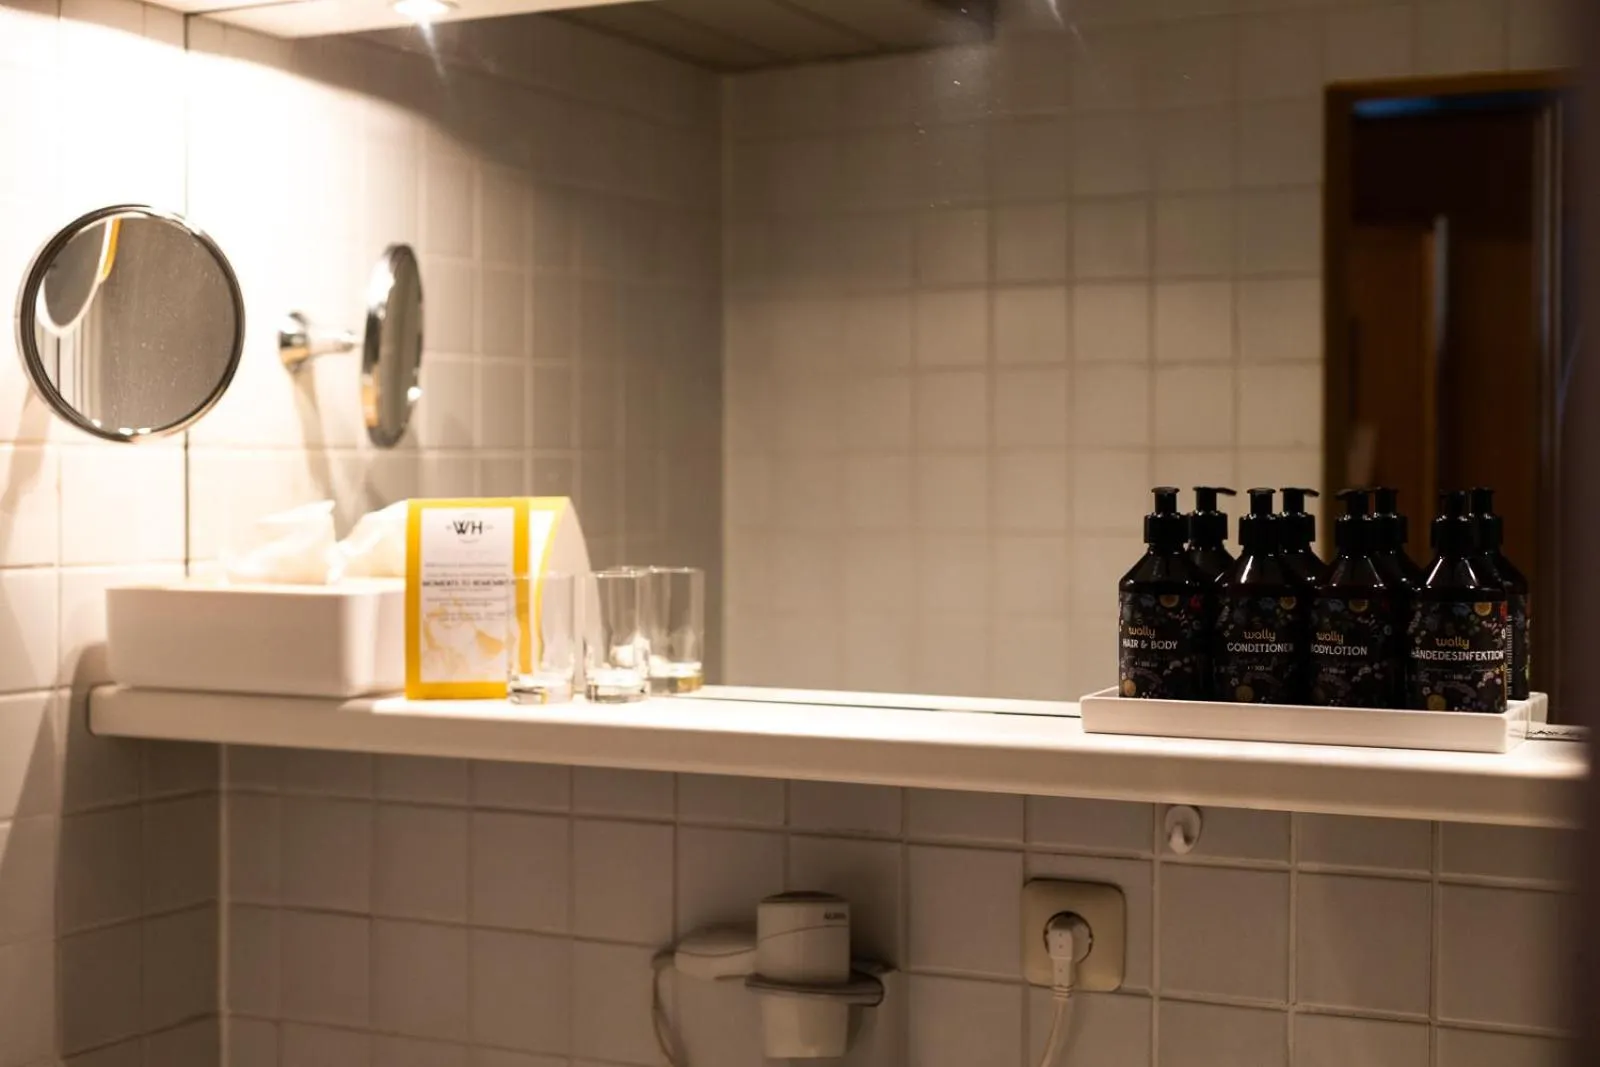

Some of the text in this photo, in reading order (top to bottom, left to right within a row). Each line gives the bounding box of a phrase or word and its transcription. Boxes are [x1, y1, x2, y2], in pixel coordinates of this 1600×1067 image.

[452, 519, 484, 535] WH
[1128, 625, 1156, 639] wally
[1243, 627, 1276, 642] wally
[1314, 630, 1344, 645] wally
[1122, 638, 1178, 650] HAIR & BODY
[1435, 635, 1470, 650] wally
